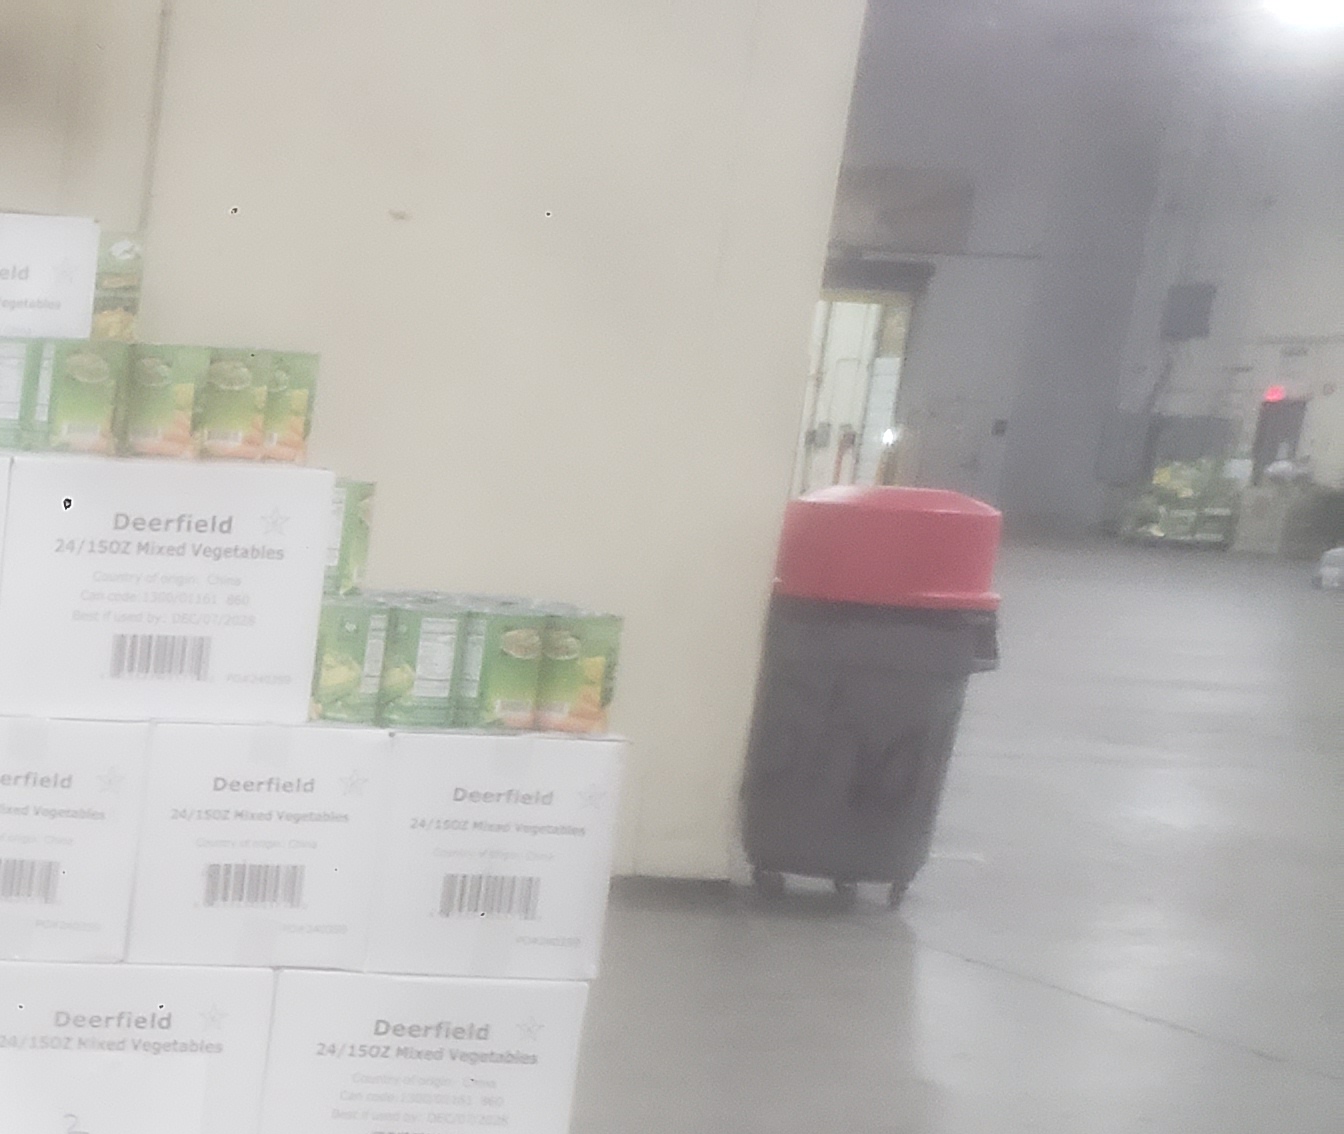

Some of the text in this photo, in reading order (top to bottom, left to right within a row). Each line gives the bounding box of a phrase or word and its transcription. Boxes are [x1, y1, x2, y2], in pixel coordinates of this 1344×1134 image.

[113, 513, 233, 534] Deerfield
[54, 539, 285, 561] 24/15OZ Mixed Vegetables
[92, 571, 141, 583] Country
[147, 573, 159, 582] of
[207, 575, 241, 586] China
[72, 611, 98, 621] Best
[103, 611, 111, 621] if
[114, 613, 143, 623] used
[213, 776, 315, 793] Deerfield
[452, 787, 554, 805] Deerfield
[33, 805, 106, 820] Vegetables
[234, 810, 273, 821] Mixed
[276, 811, 349, 824] Vegetables
[473, 821, 511, 832] Mixed
[515, 823, 585, 836] Vegetables
[53, 1010, 173, 1030] Deerfield
[374, 1019, 491, 1040] Deerfield
[77, 1037, 126, 1051] Mixed
[130, 1038, 224, 1055] Vegetables
[316, 1042, 538, 1065] 24/15OZ Mixed Vegetables
